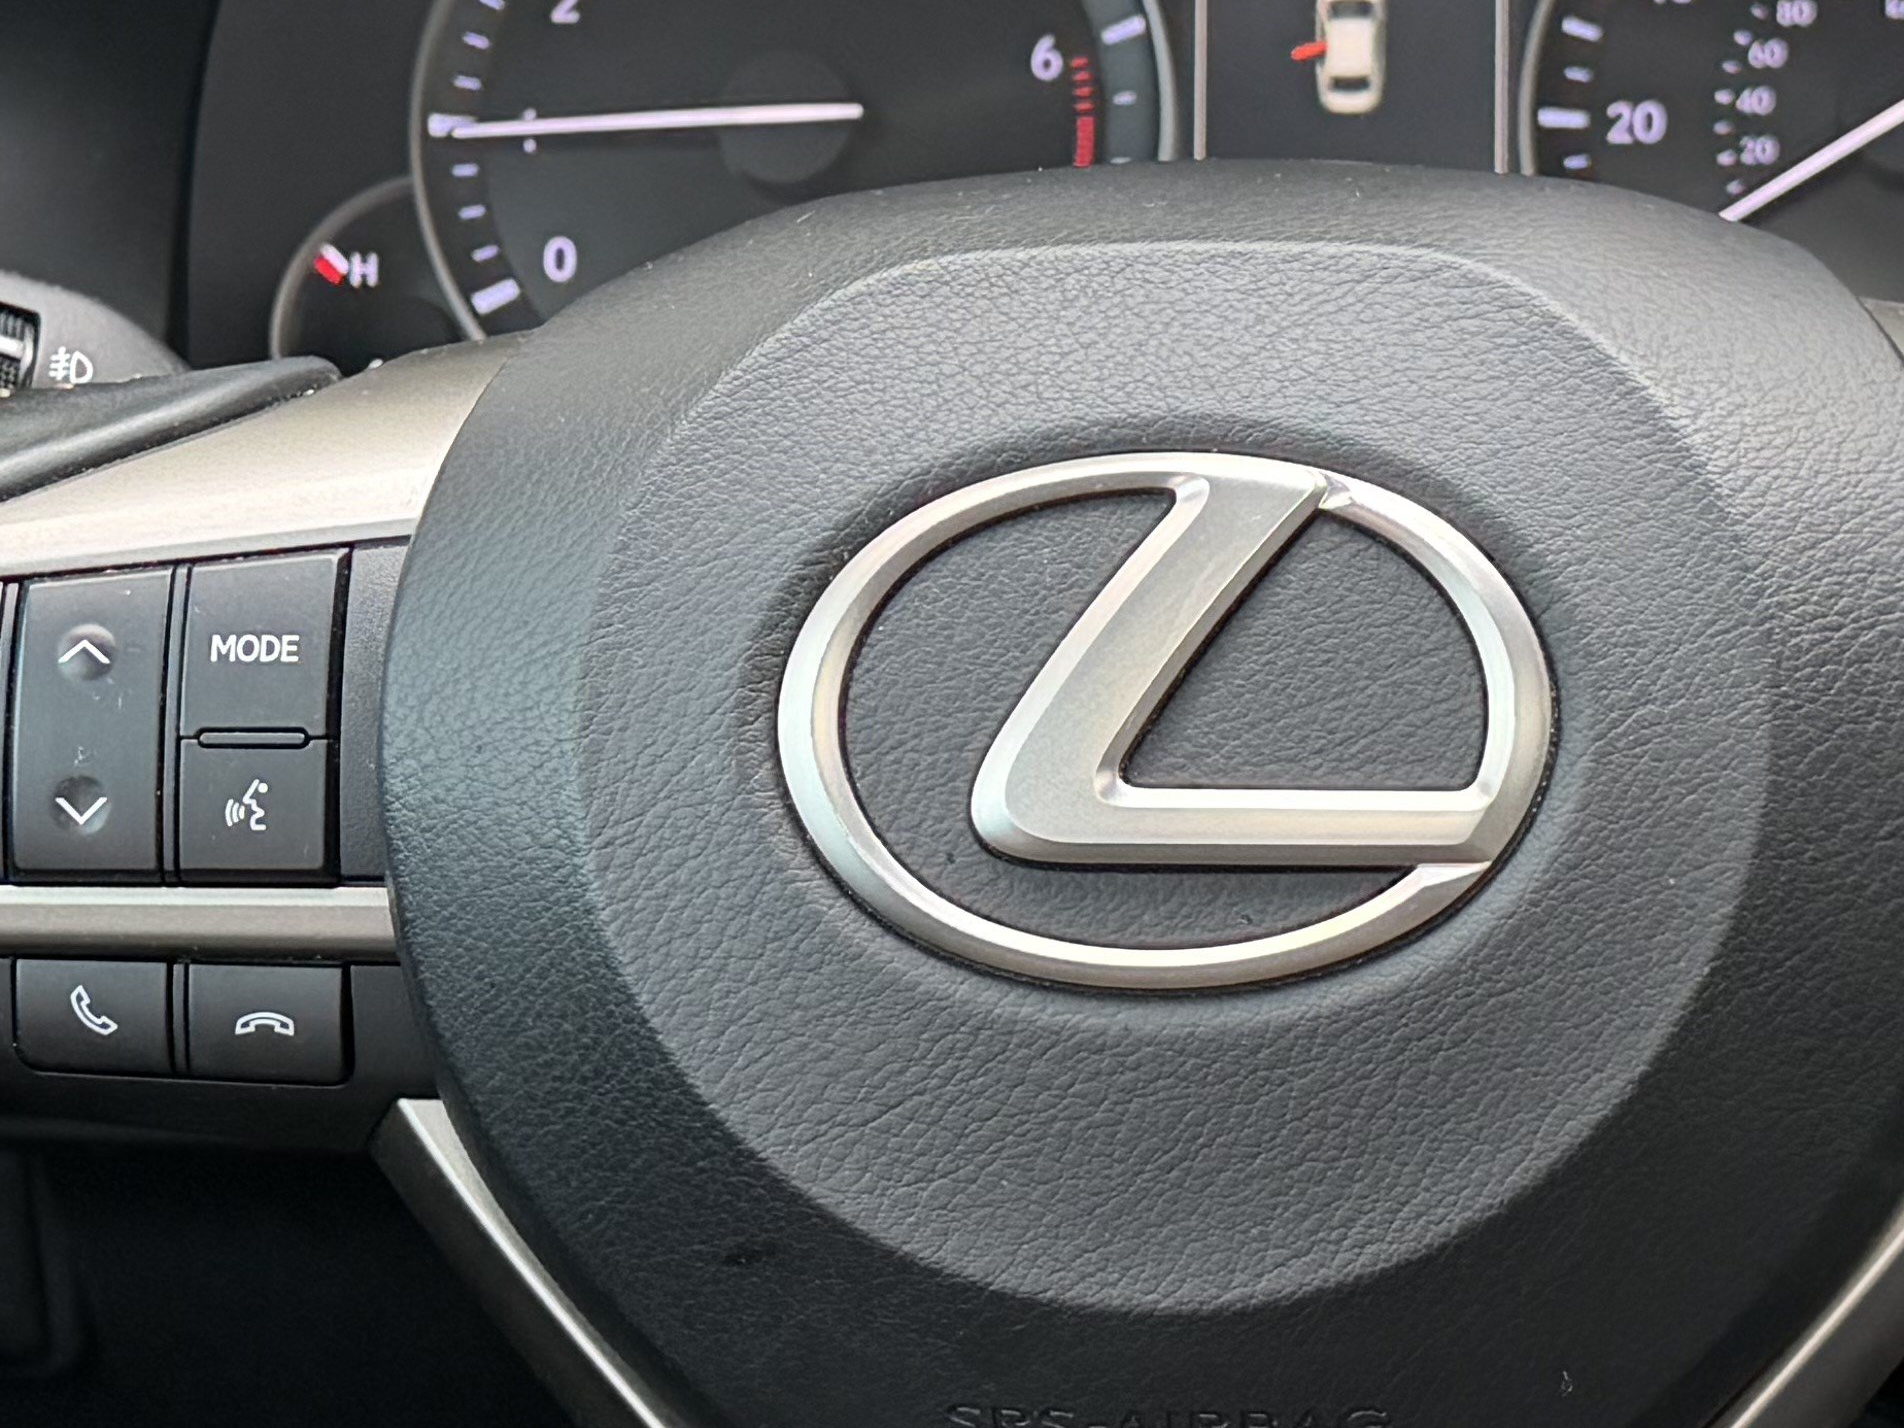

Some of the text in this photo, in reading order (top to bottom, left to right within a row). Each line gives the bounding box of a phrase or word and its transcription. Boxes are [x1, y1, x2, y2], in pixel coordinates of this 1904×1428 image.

[1030, 34, 1063, 81] 6
[1747, 37, 1789, 69] 60
[1736, 85, 1777, 116] 40
[1606, 101, 1668, 146] 20
[1739, 134, 1780, 166] 20
[350, 256, 378, 286] H
[544, 236, 577, 282] 0
[210, 634, 300, 664] MODE
